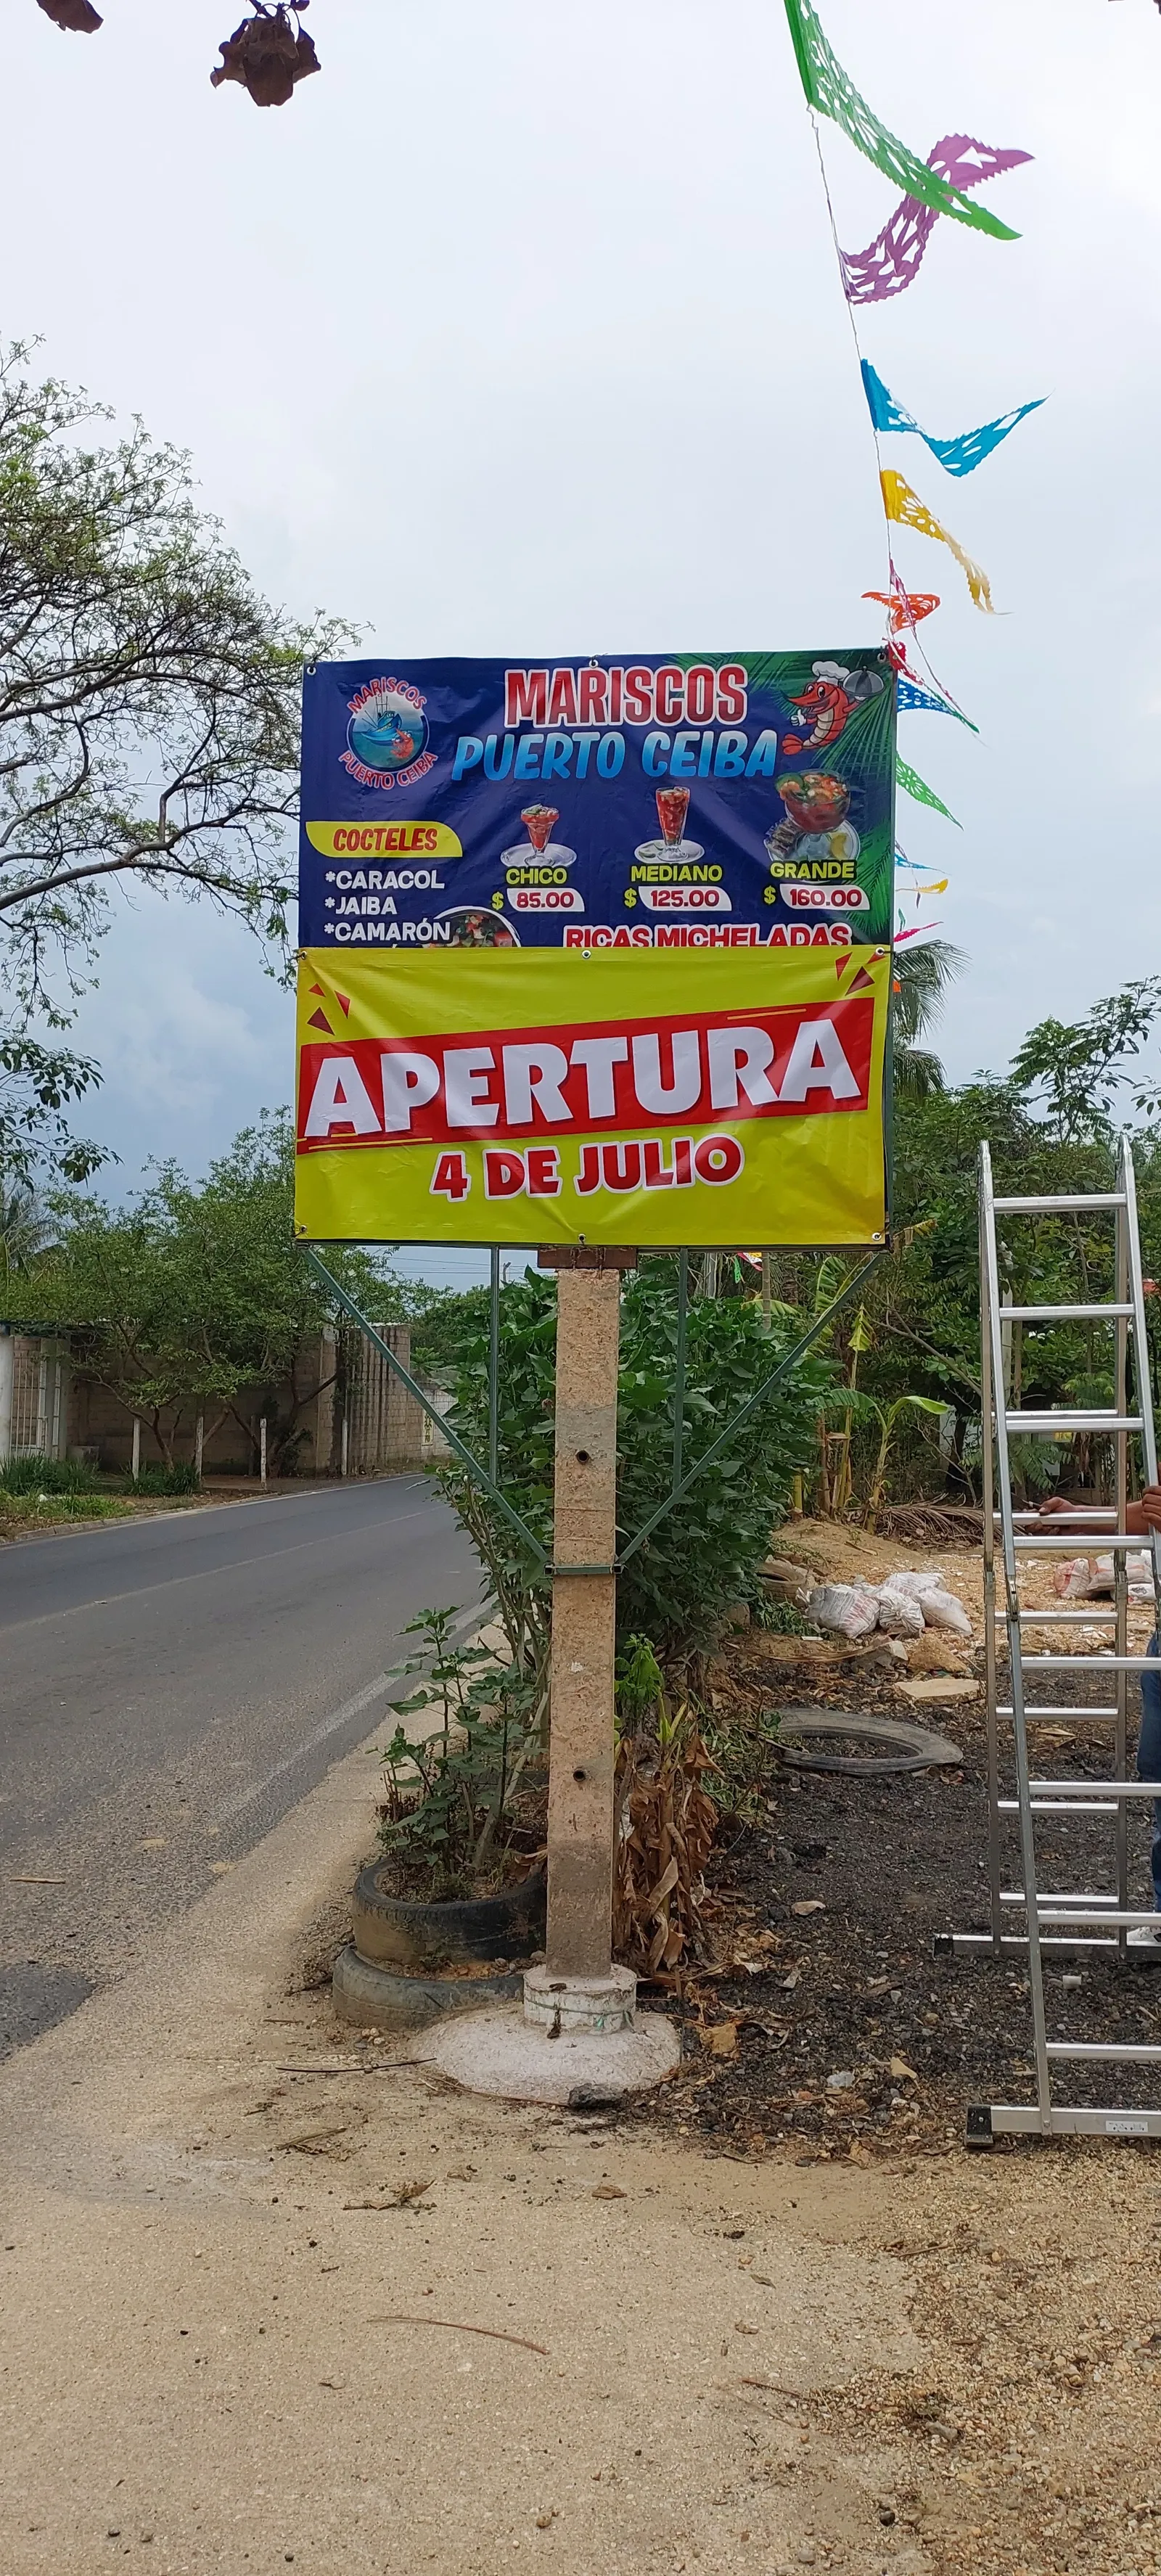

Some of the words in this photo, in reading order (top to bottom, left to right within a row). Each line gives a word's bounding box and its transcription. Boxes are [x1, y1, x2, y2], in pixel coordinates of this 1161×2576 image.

[347, 676, 427, 714] MARISCOS
[505, 665, 748, 728] MARISCOS
[451, 731, 625, 782] PUERTO
[642, 729, 778, 778] CEIBA
[339, 750, 395, 790] PUERTO
[397, 751, 438, 787] CEIBA
[333, 828, 438, 851] COCTELES
[506, 868, 567, 885] CHICO
[631, 865, 723, 882] MEDIANO
[770, 861, 855, 879] GRANDE
[517, 893, 574, 908] 85.00
[650, 890, 720, 907] 125.00
[789, 888, 862, 906] 160.00
[564, 925, 653, 947] RICAS
[655, 923, 852, 947] MICHELADAS
[305, 1019, 861, 1137] APERTURA
[430, 1151, 471, 1202] 4
[484, 1146, 562, 1199] DE
[574, 1133, 745, 1196] JULIO
